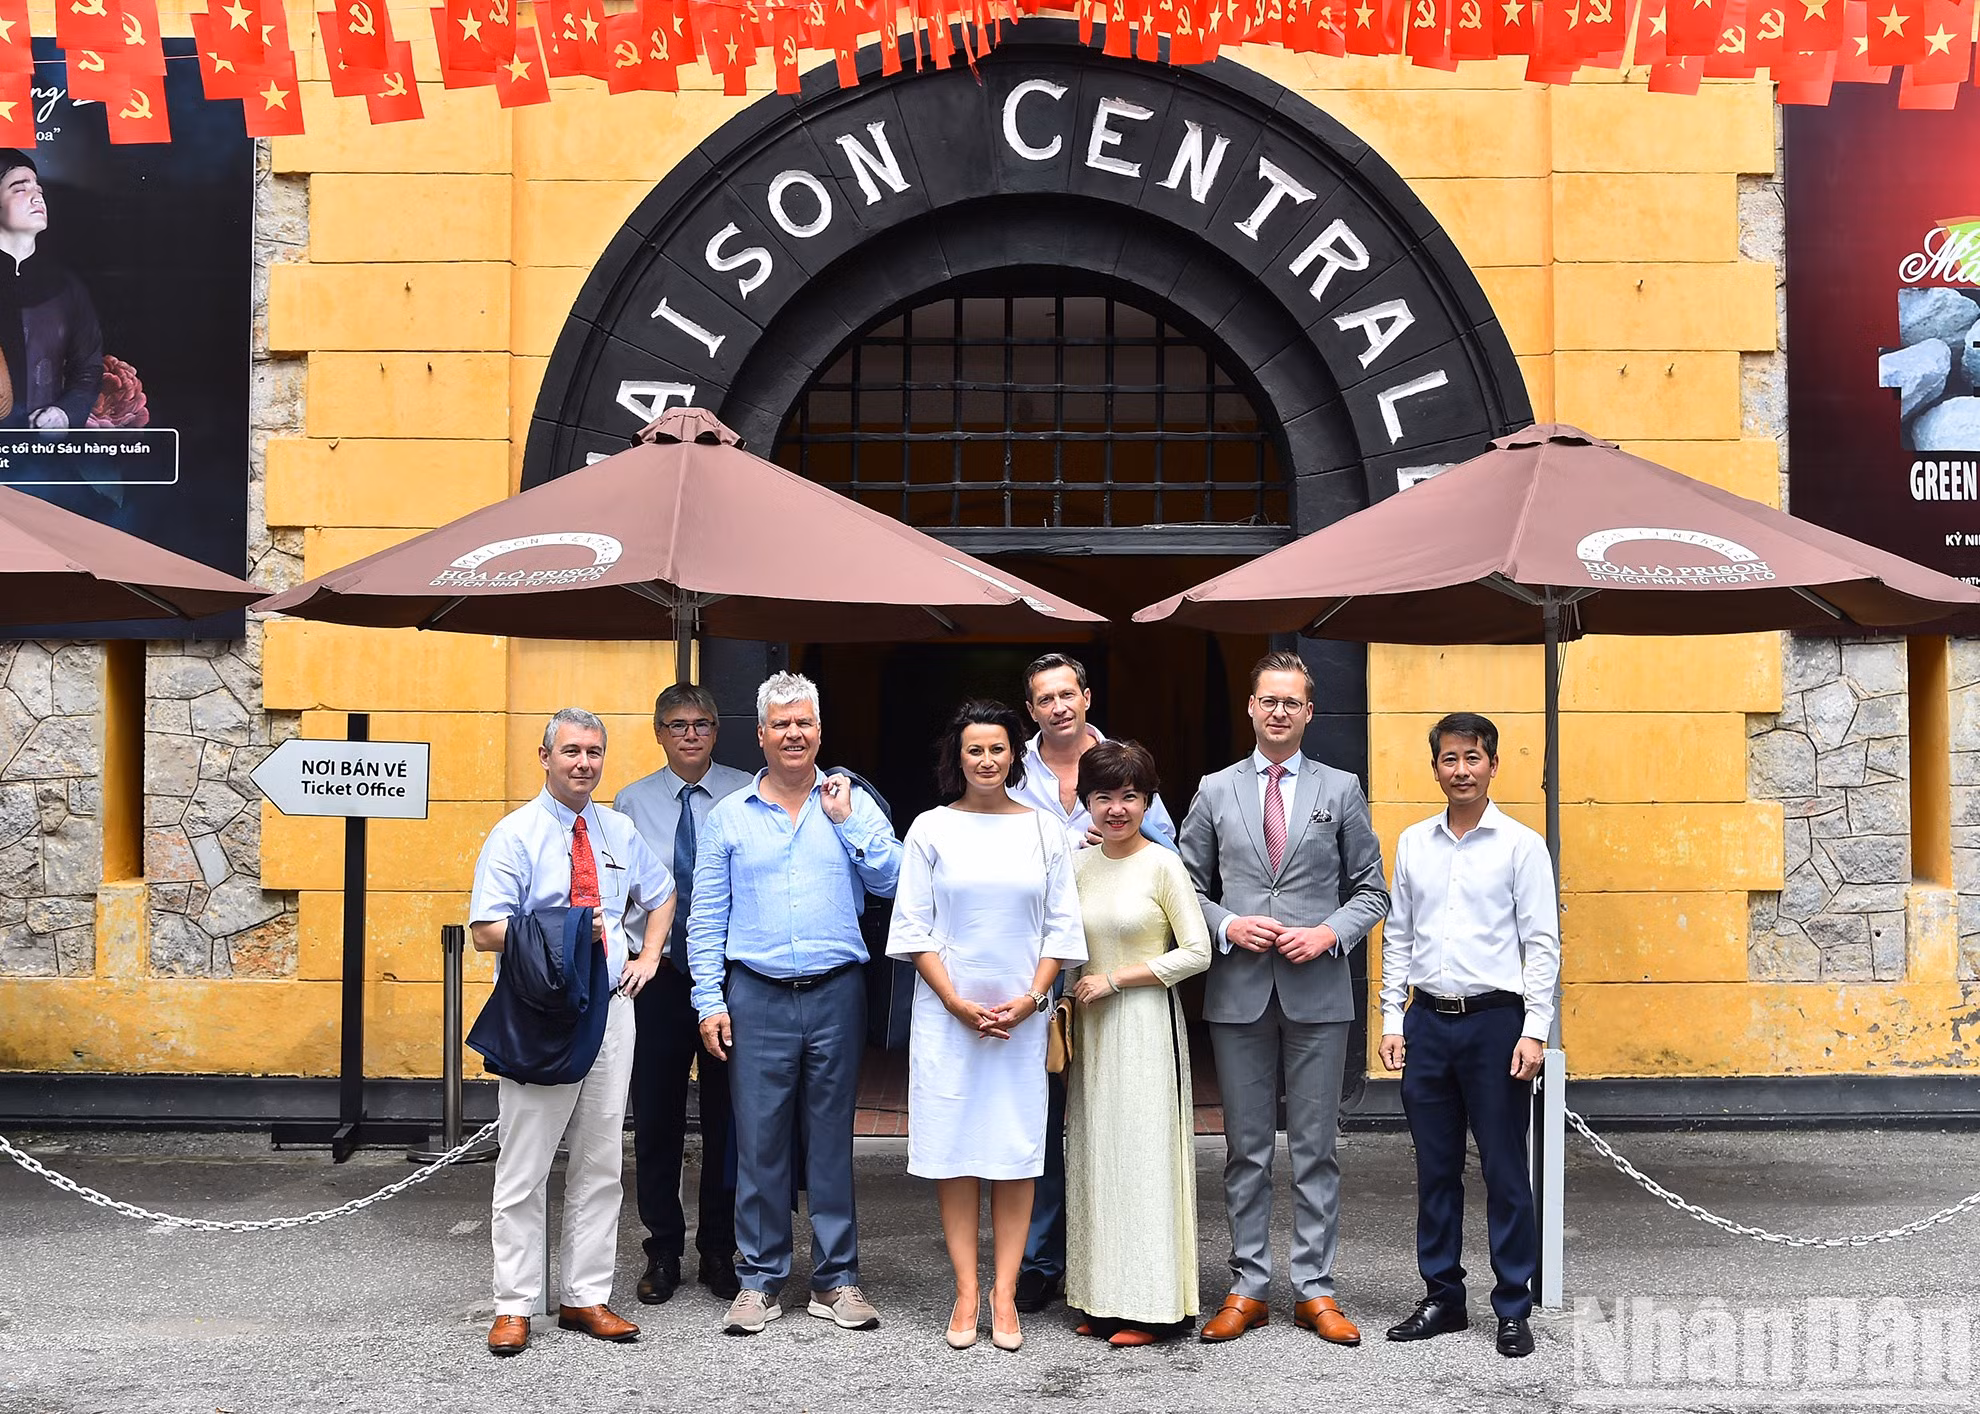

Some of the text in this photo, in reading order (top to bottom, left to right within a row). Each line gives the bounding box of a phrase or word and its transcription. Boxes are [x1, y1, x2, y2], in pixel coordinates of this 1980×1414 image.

[30, 86, 67, 124] ng
[585, 119, 912, 466] AISON
[11, 442, 29, 454] tối
[31, 443, 55, 454] thứ
[57, 443, 81, 454] Sáu
[84, 443, 118, 456] hàng
[121, 442, 151, 454] tuần
[1909, 460, 1977, 501] GREEN
[1965, 534, 1980, 547] NI
[526, 563, 615, 579] PRISON
[1676, 561, 1769, 576] PRISON
[301, 758, 407, 778] NƠI BÁN VÉ
[301, 780, 406, 797] Ticket Office
